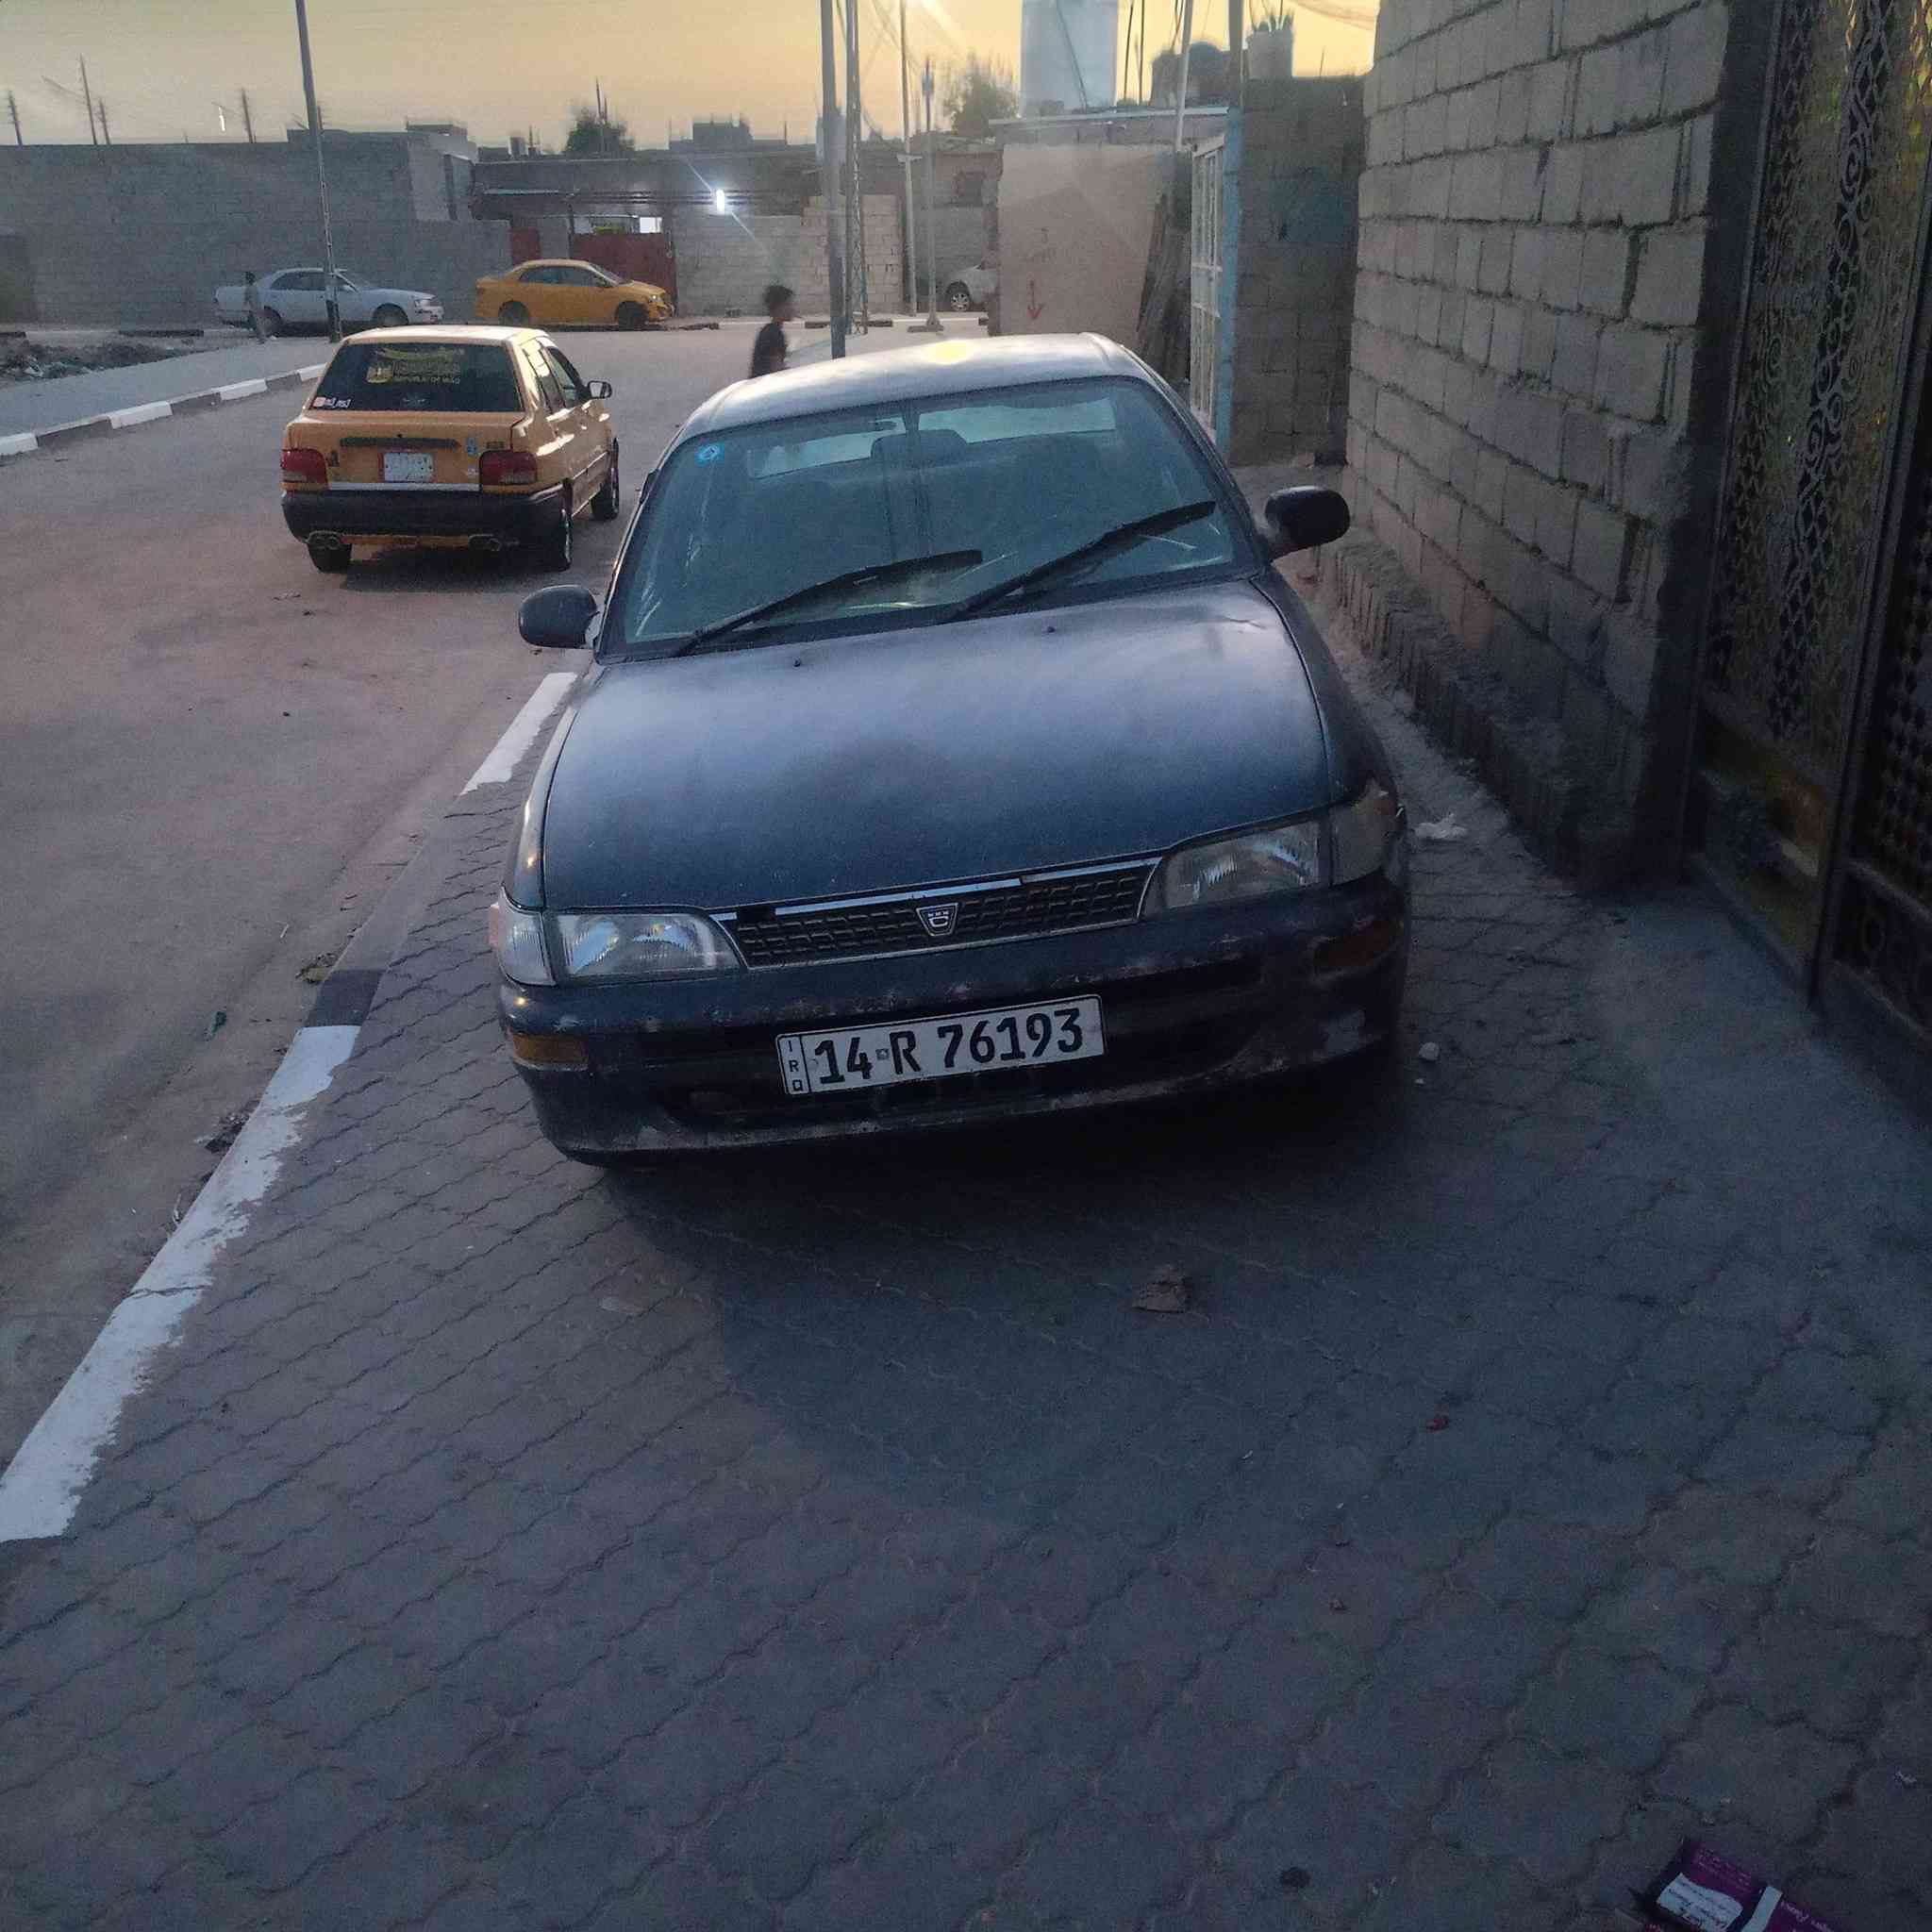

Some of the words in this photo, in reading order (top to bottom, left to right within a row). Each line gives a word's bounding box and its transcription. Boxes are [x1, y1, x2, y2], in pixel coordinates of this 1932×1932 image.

[814, 1038, 874, 1084] 14
[889, 1030, 922, 1074] R
[937, 1008, 1084, 1069] 76193
